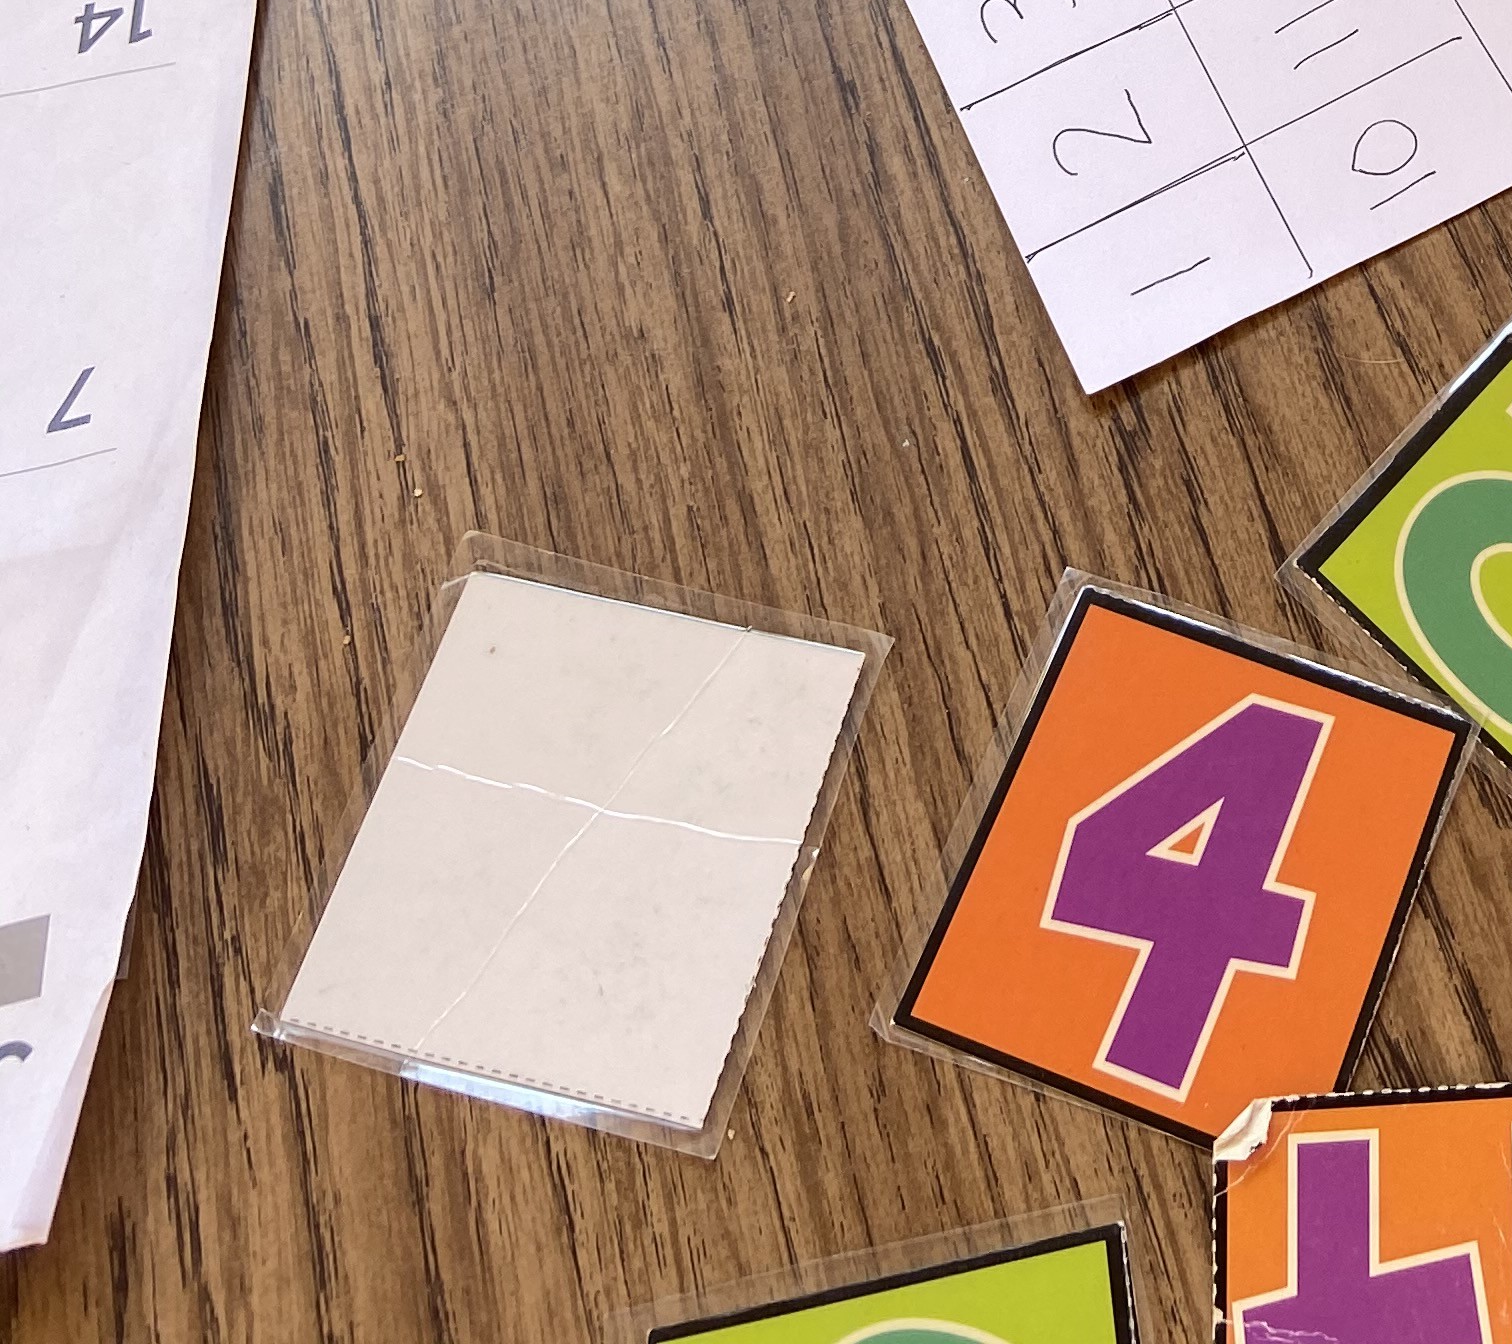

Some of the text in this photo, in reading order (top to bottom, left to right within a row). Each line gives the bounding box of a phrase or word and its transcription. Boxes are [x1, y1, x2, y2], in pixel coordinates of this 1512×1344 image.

[1052, 89, 1152, 176] 2
[1352, 118, 1437, 211] 10
[1130, 256, 1211, 296] 1
[46, 366, 95, 435] 7
[1040, 691, 1337, 1102] 4
